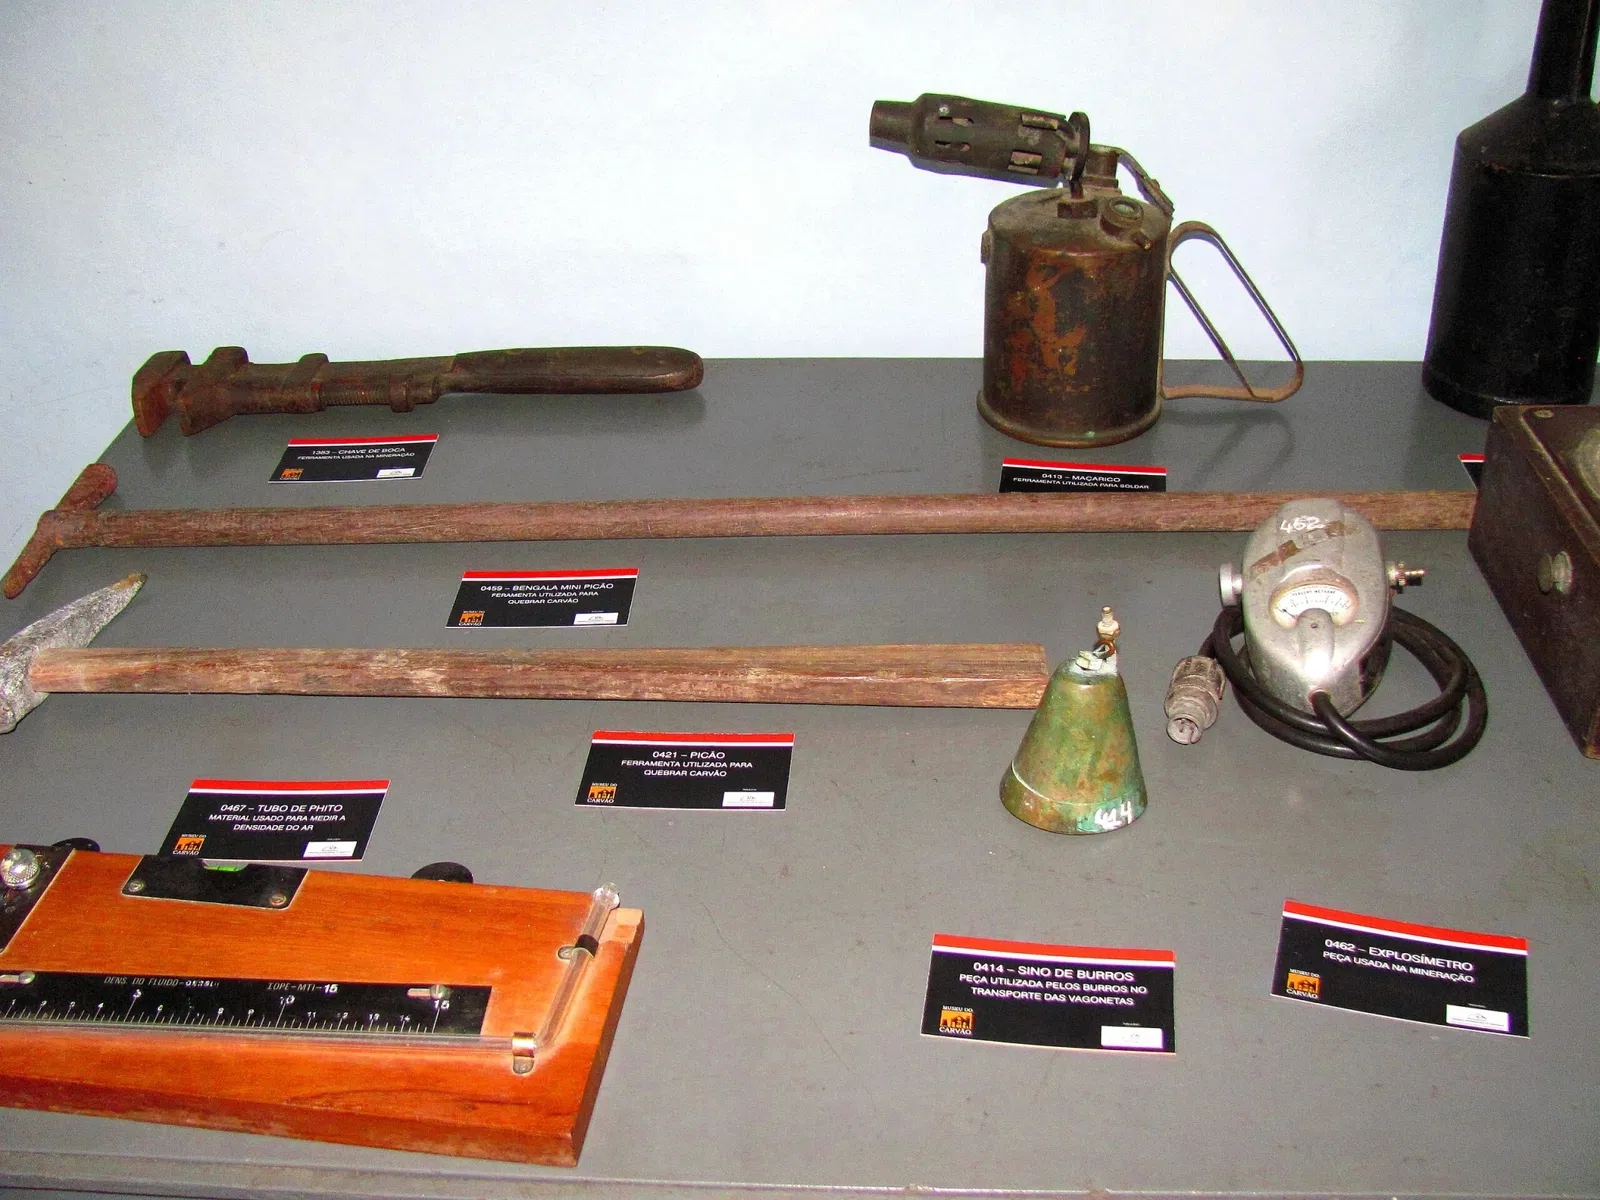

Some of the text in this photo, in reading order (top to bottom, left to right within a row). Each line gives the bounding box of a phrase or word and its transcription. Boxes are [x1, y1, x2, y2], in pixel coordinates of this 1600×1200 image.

[690, 751, 725, 759] PICÃO
[220, 804, 247, 812] 0467
[1325, 939, 1355, 951] 0462
[1369, 947, 1473, 971] EXPLOSÍMETRO
[973, 962, 1004, 972] 0414
[1018, 965, 1050, 976] SINO
[1055, 968, 1073, 978] DE
[1077, 970, 1134, 981] BURROS
[1323, 951, 1474, 983] PEÇA USADA NA MINERAÇÃO
[959, 974, 1147, 994] PEÇA UTILIZADA PELOS BURROS NO
[971, 987, 1134, 1005] TRANSPORTE DAS VAGONETAS
[1287, 989, 1318, 998] CARVÃO
